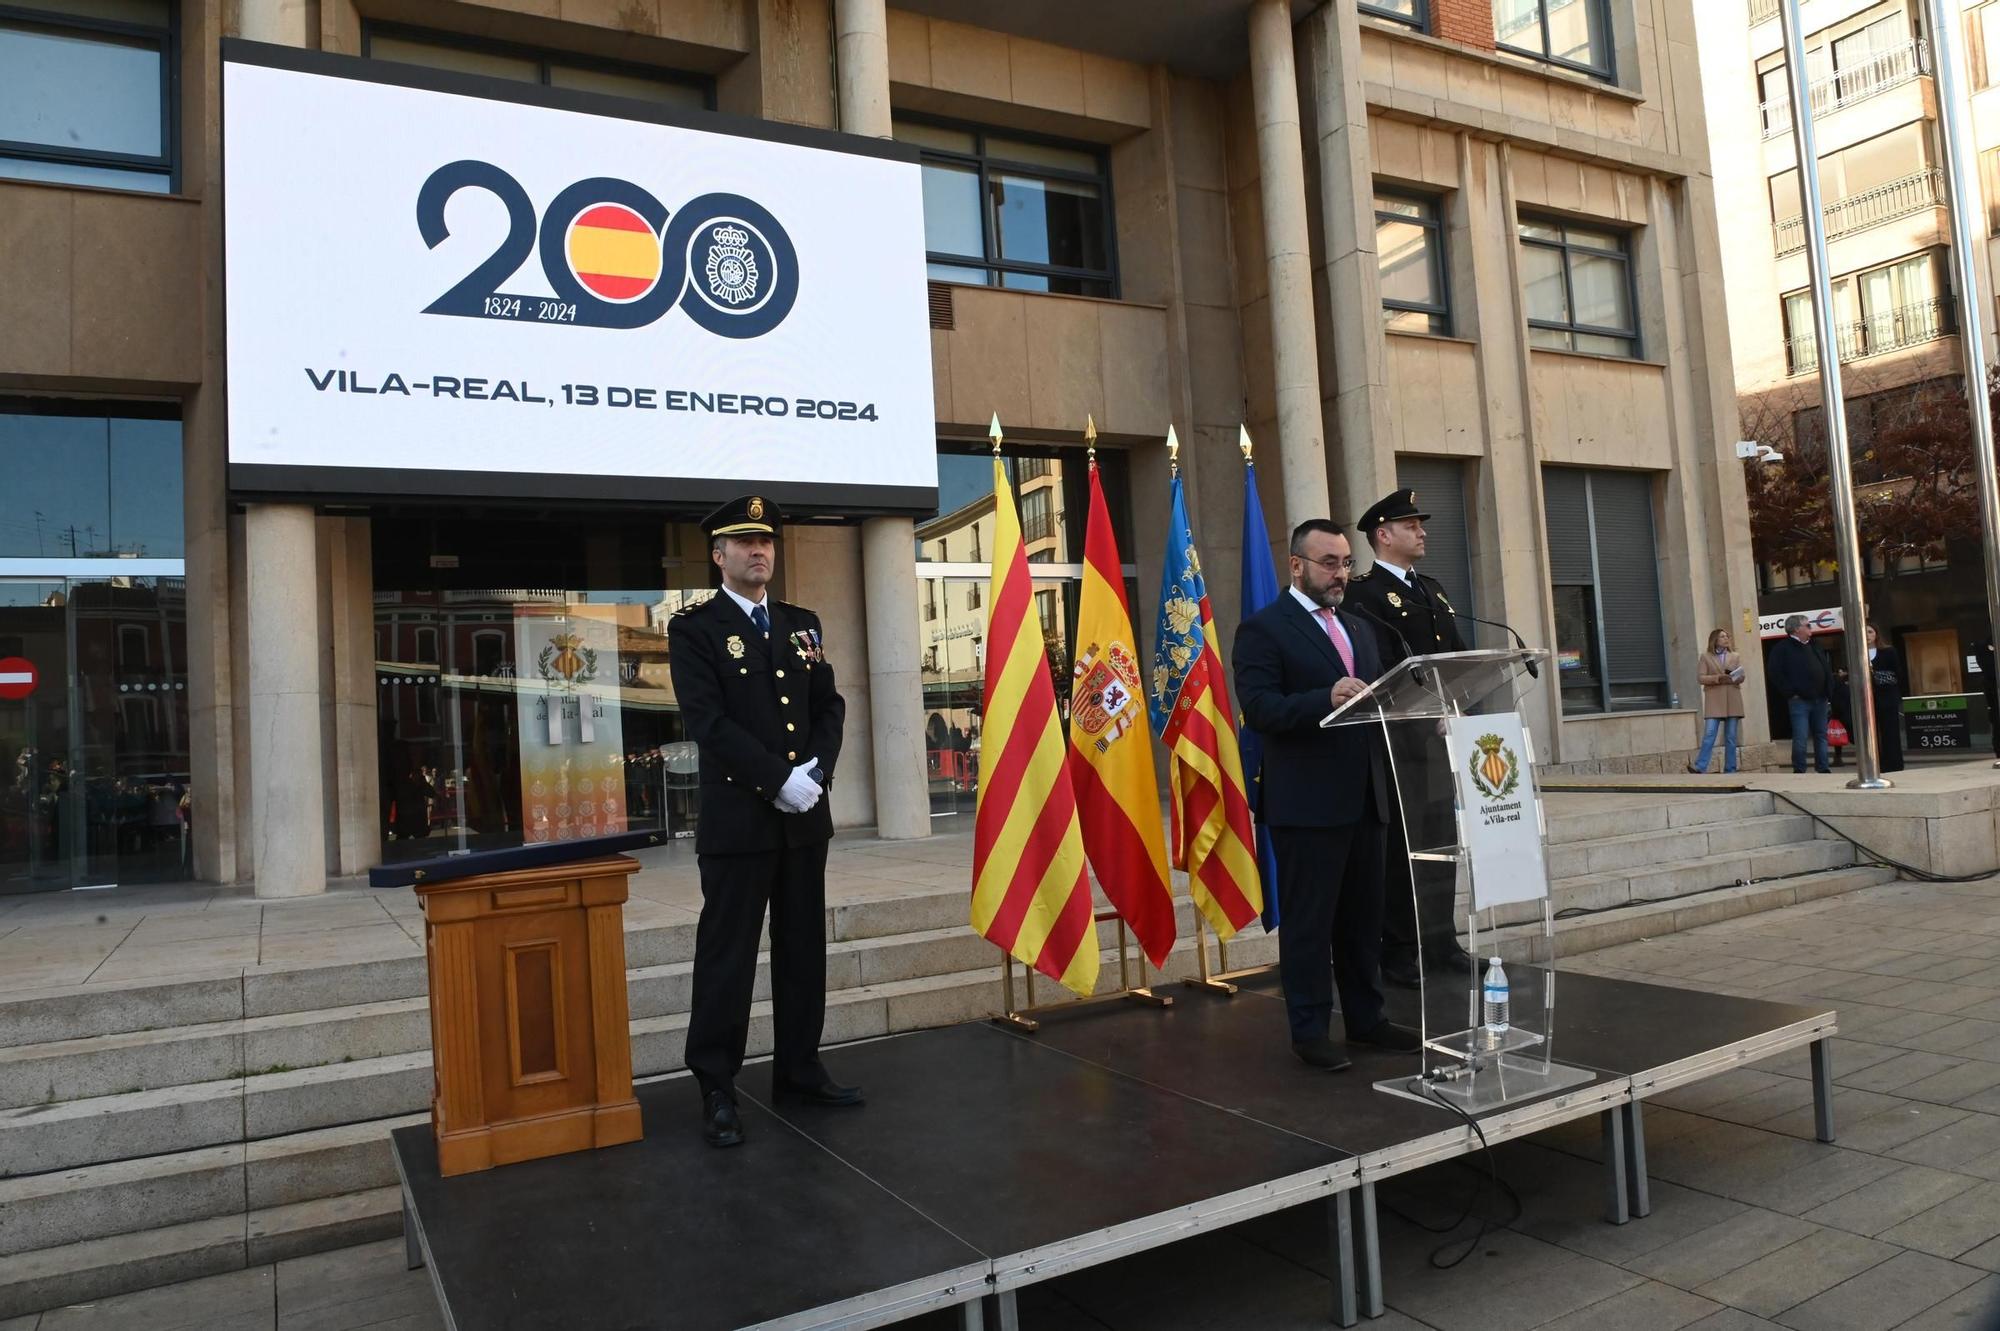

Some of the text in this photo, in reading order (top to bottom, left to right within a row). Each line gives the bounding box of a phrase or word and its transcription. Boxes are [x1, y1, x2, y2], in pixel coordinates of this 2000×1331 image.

[417, 160, 800, 340] 200
[484, 296, 577, 321] 1824 2024
[304, 367, 879, 422] VILA-REAL, 13 DE ENERO 2024
[1480, 801, 1521, 815] Ajuntament
[1490, 811, 1521, 824] Vila-real
